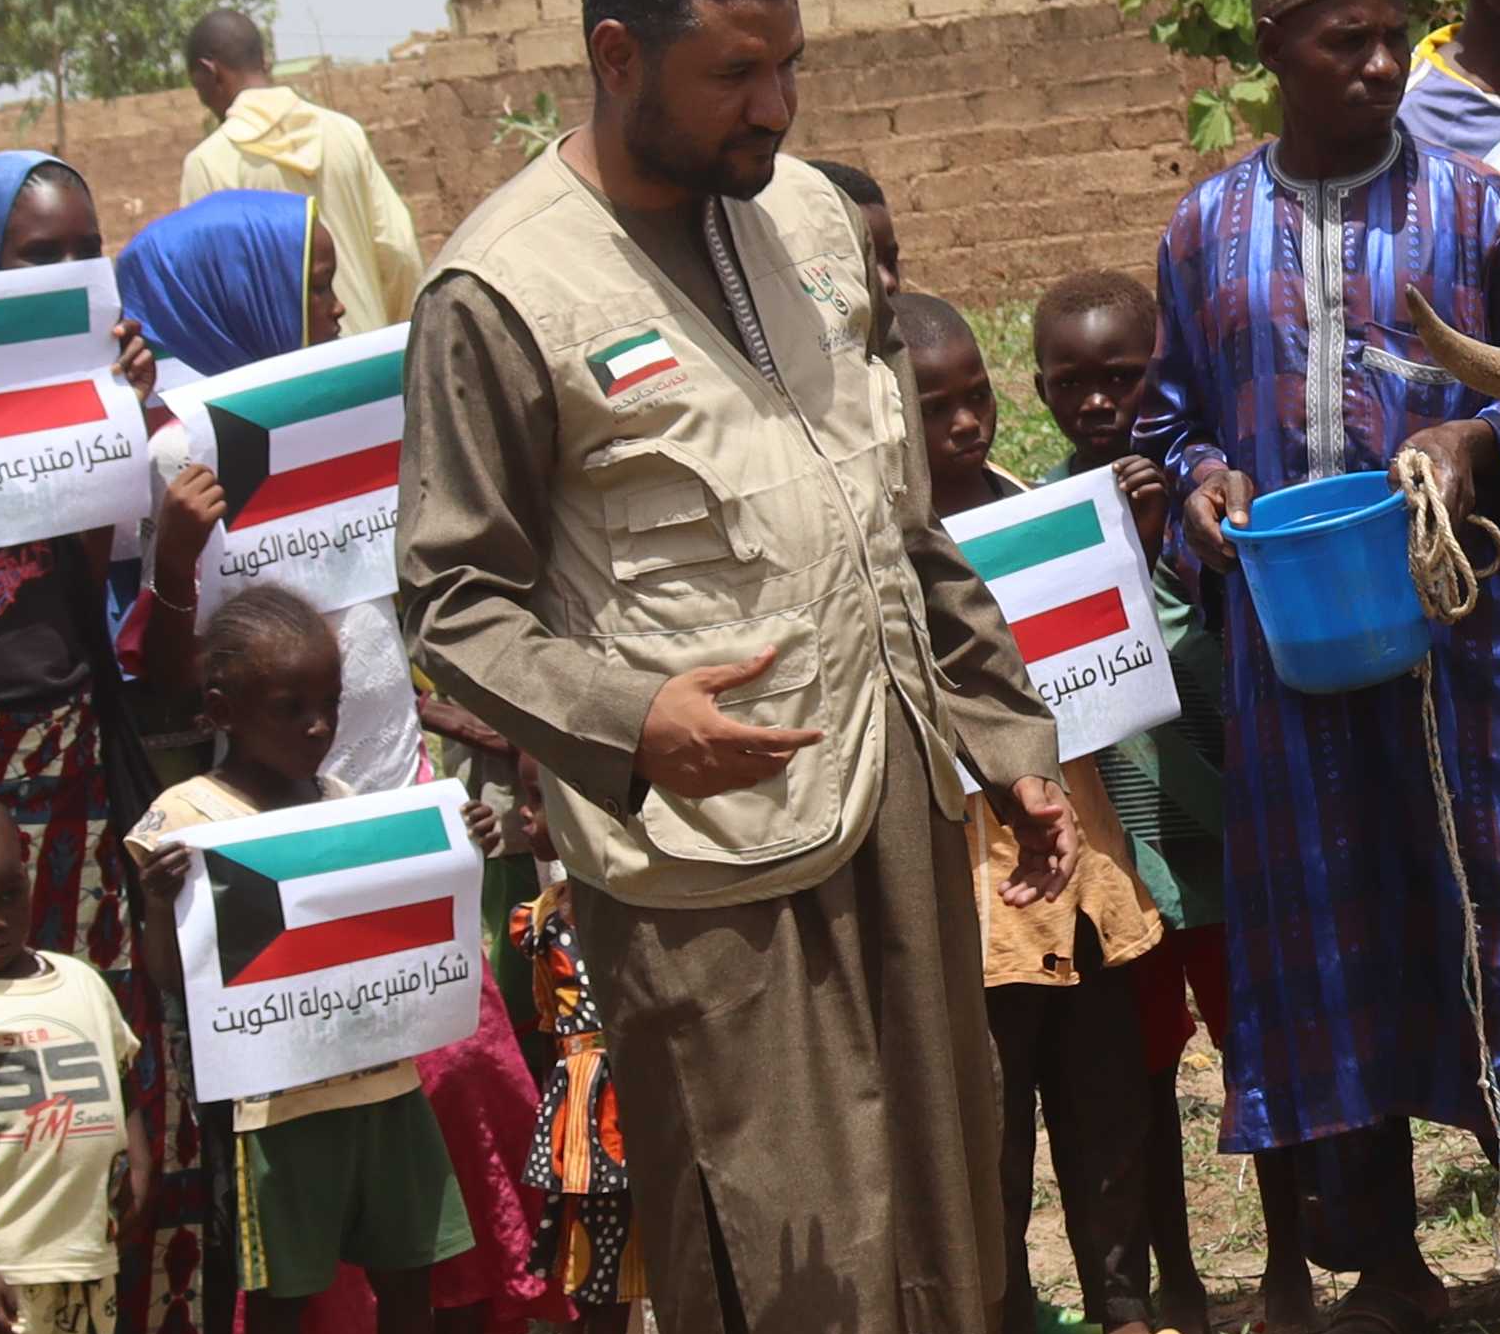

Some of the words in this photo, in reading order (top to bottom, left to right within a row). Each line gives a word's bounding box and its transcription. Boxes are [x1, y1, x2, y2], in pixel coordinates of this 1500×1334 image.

[74, 433, 133, 475] شكرا
[220, 534, 284, 577] الكويت
[287, 527, 331, 560] دولة
[1098, 640, 1153, 686] شكرا
[1038, 667, 1098, 707] متبرع
[347, 968, 421, 1016] متبرعي
[423, 953, 470, 995] شكرا
[213, 992, 295, 1035] الكويت
[299, 987, 344, 1020] دولة
